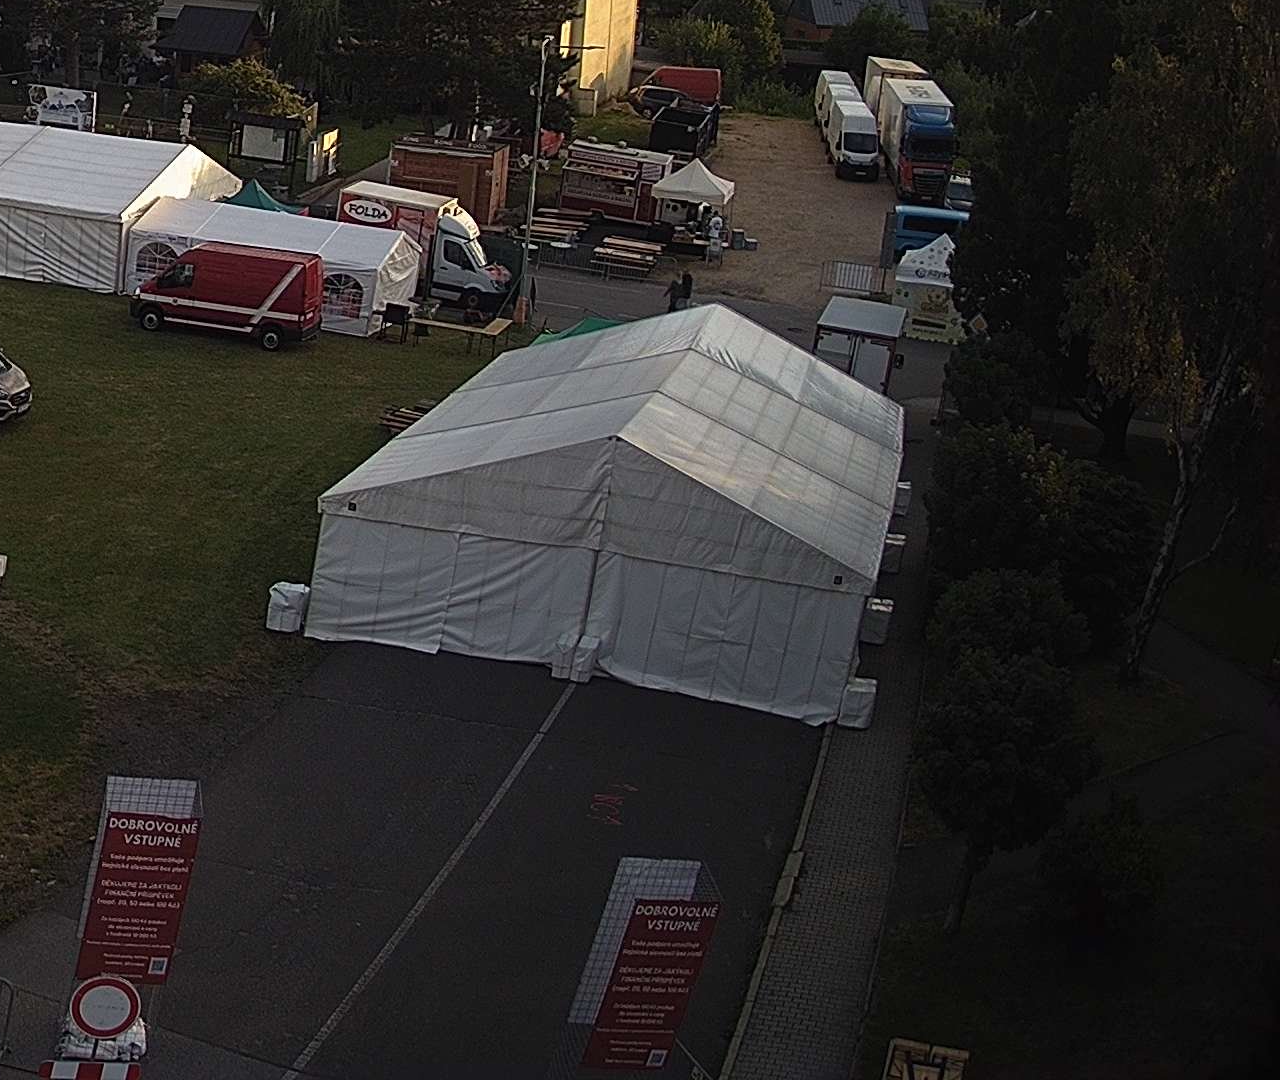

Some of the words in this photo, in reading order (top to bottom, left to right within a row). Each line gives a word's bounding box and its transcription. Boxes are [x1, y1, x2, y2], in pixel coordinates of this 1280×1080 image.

[348, 203, 388, 220] FOLDA
[109, 817, 198, 834] DOBROVOLNÉ
[124, 833, 182, 848] VSTUPNÉ
[635, 904, 719, 918] DOBROVOLNÉ
[647, 919, 701, 932] VSTUPNÉ
